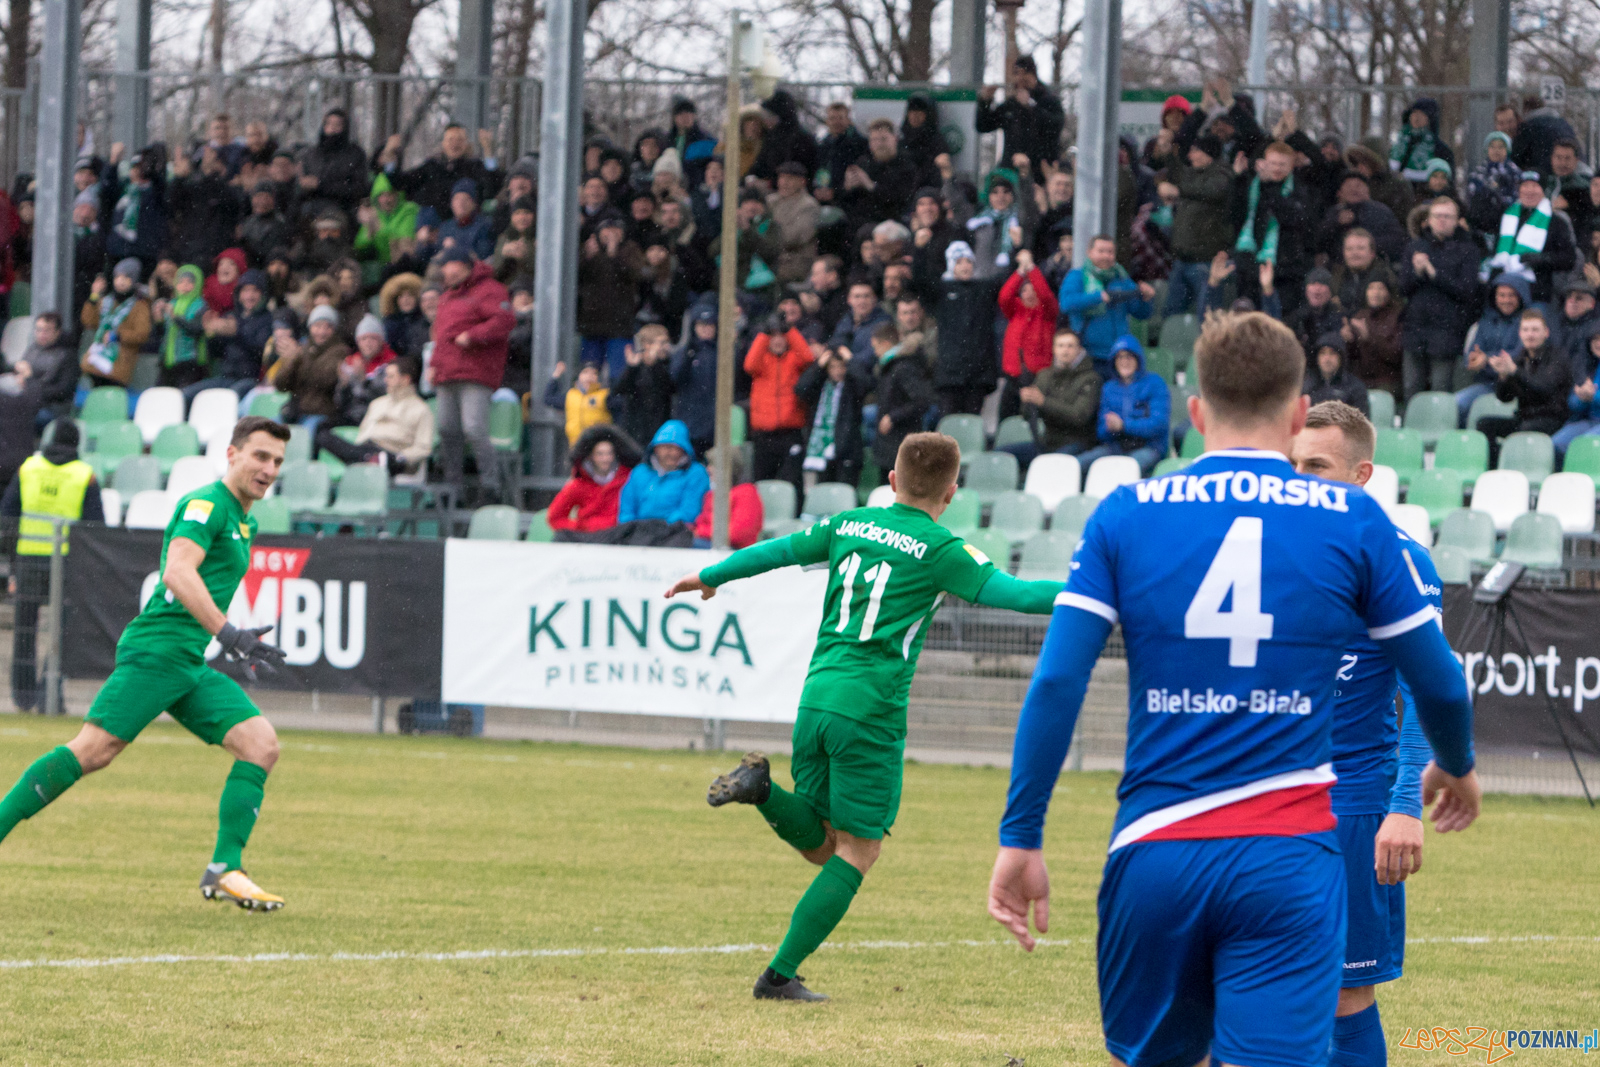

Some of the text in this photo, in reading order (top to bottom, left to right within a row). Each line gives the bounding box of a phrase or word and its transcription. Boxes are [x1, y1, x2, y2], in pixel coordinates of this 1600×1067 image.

[1136, 470, 1350, 513] WIKTORSKI
[835, 519, 928, 560] JAKÓBOWSKI
[834, 551, 893, 642] 11
[1184, 515, 1275, 668] 4
[527, 597, 754, 668] KINGA
[545, 657, 736, 697] PIENIŃSKA
